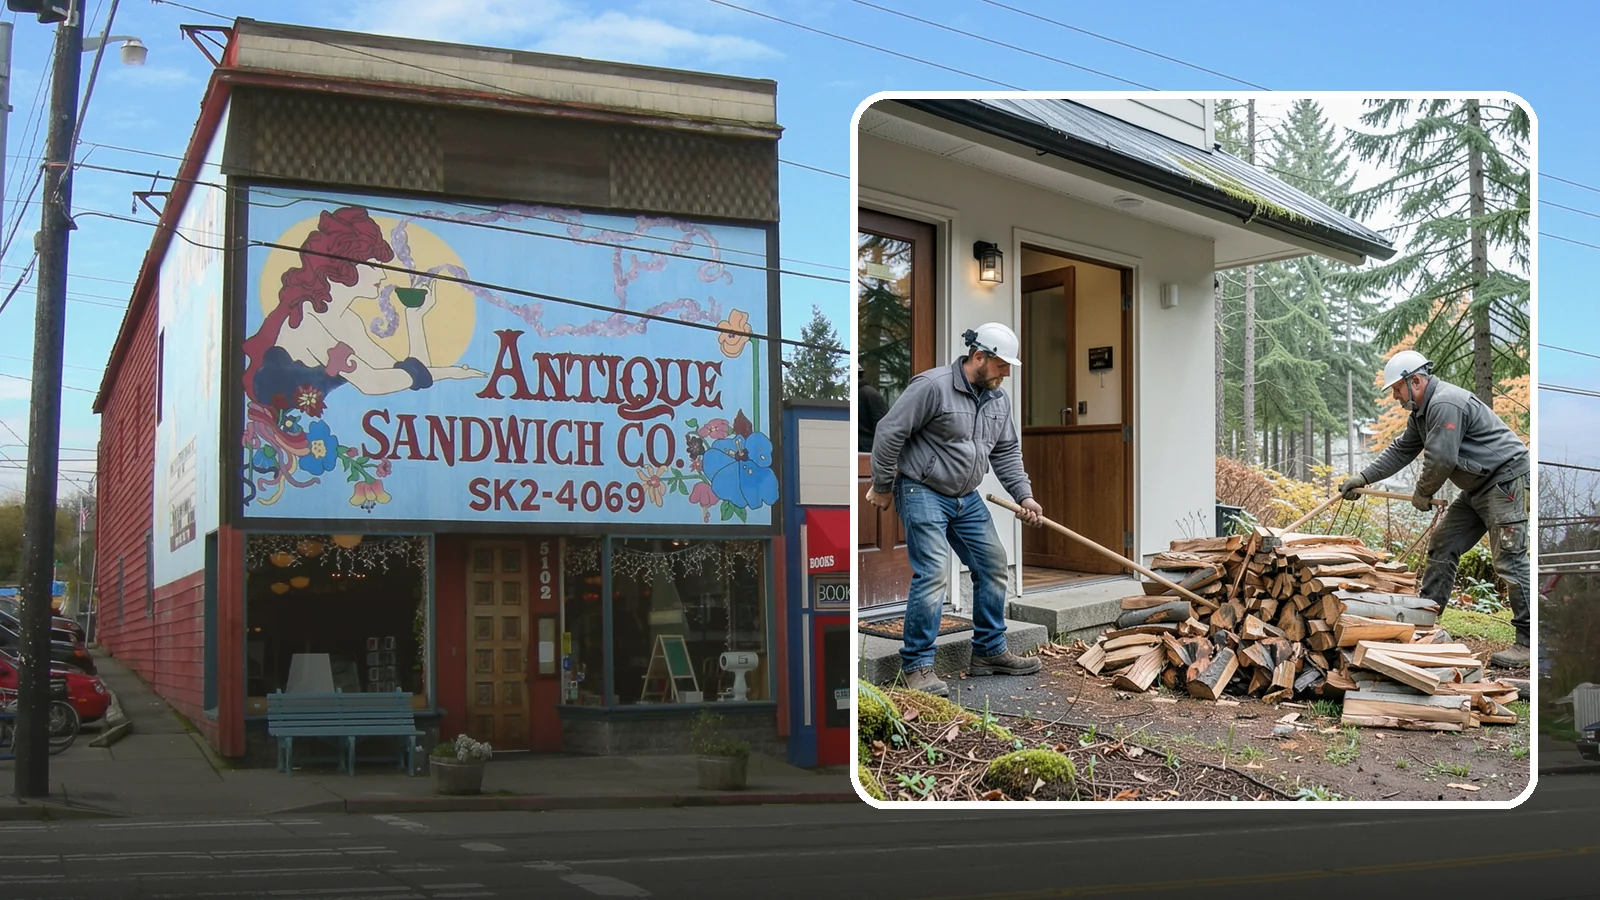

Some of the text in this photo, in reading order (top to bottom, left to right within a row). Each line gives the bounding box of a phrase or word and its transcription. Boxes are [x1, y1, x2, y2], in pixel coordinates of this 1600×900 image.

[475, 329, 723, 421] ANTIQUE
[361, 408, 685, 470] SANDWICH CO.
[468, 476, 646, 513] SK2-4069
[539, 541, 552, 600] 5102
[809, 555, 835, 569] BOOKS
